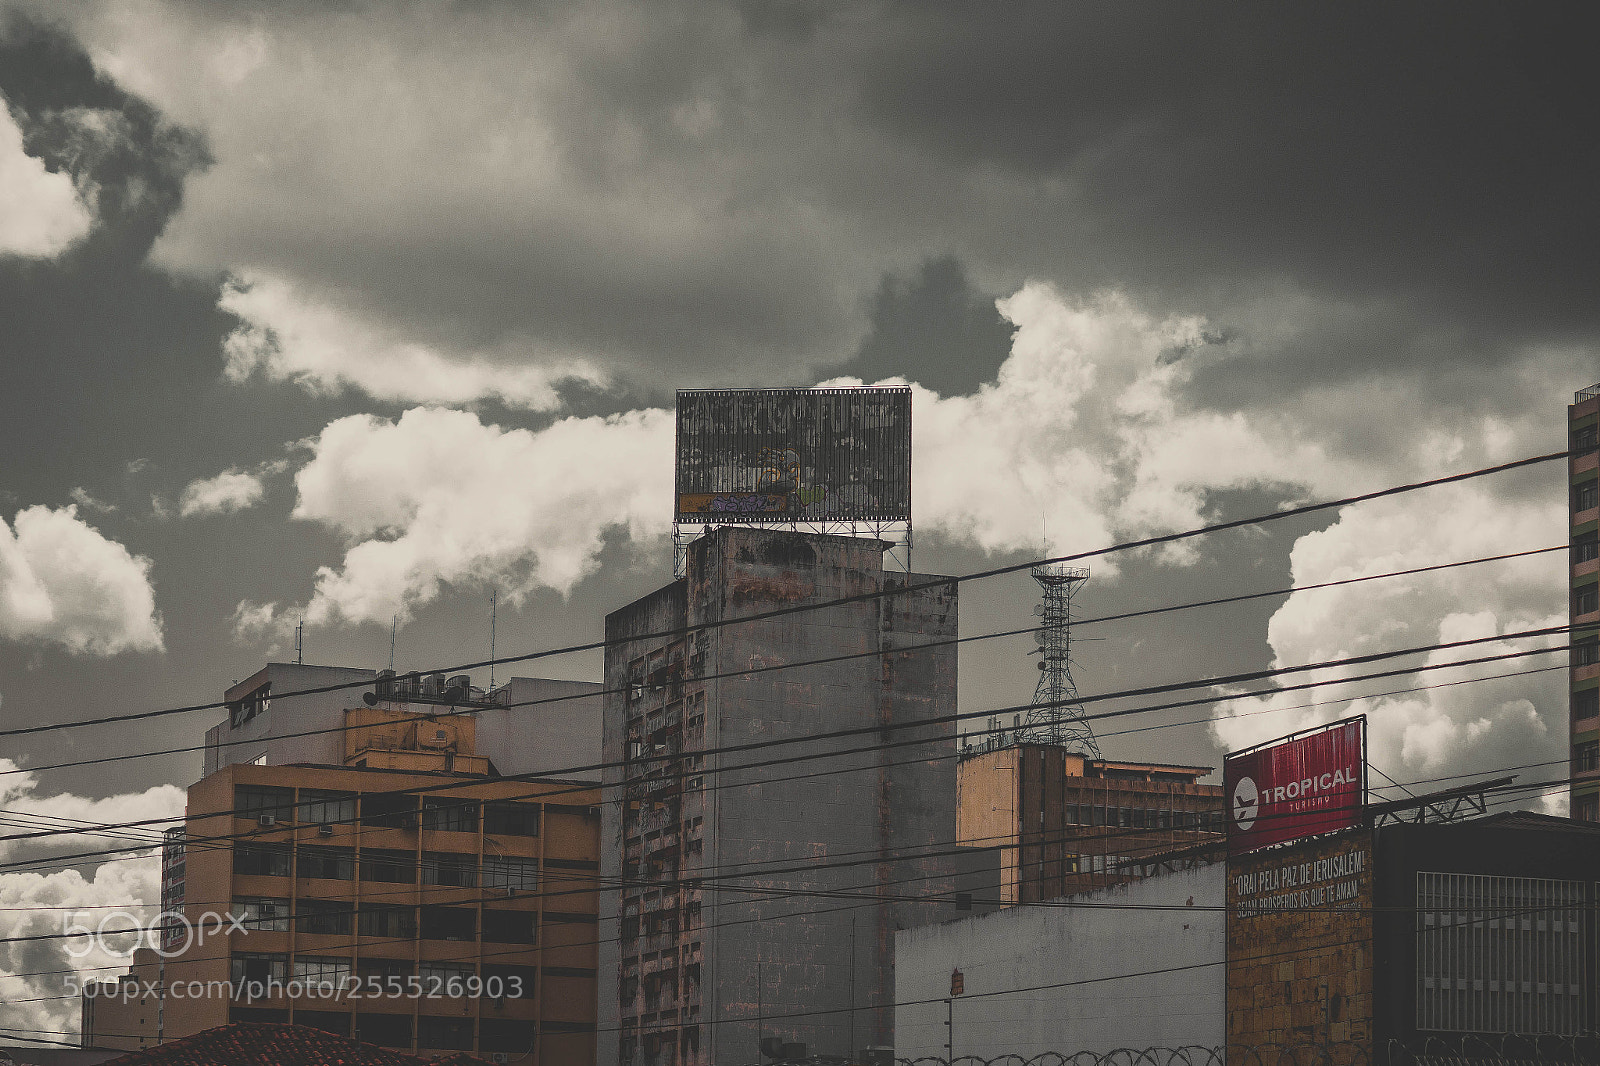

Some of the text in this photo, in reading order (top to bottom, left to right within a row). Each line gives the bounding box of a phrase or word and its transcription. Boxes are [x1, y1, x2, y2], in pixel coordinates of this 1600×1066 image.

[1262, 768, 1357, 804] TROPICAL
[1290, 795, 1330, 812] TURISMO
[1259, 869, 1280, 892] PELA
[1282, 865, 1298, 888] PAZ
[1300, 862, 1311, 885] DE
[1312, 849, 1365, 882] JERUSALÉM!
[1300, 889, 1309, 909] OS
[1311, 886, 1324, 907] QUE
[1326, 884, 1335, 904] TE
